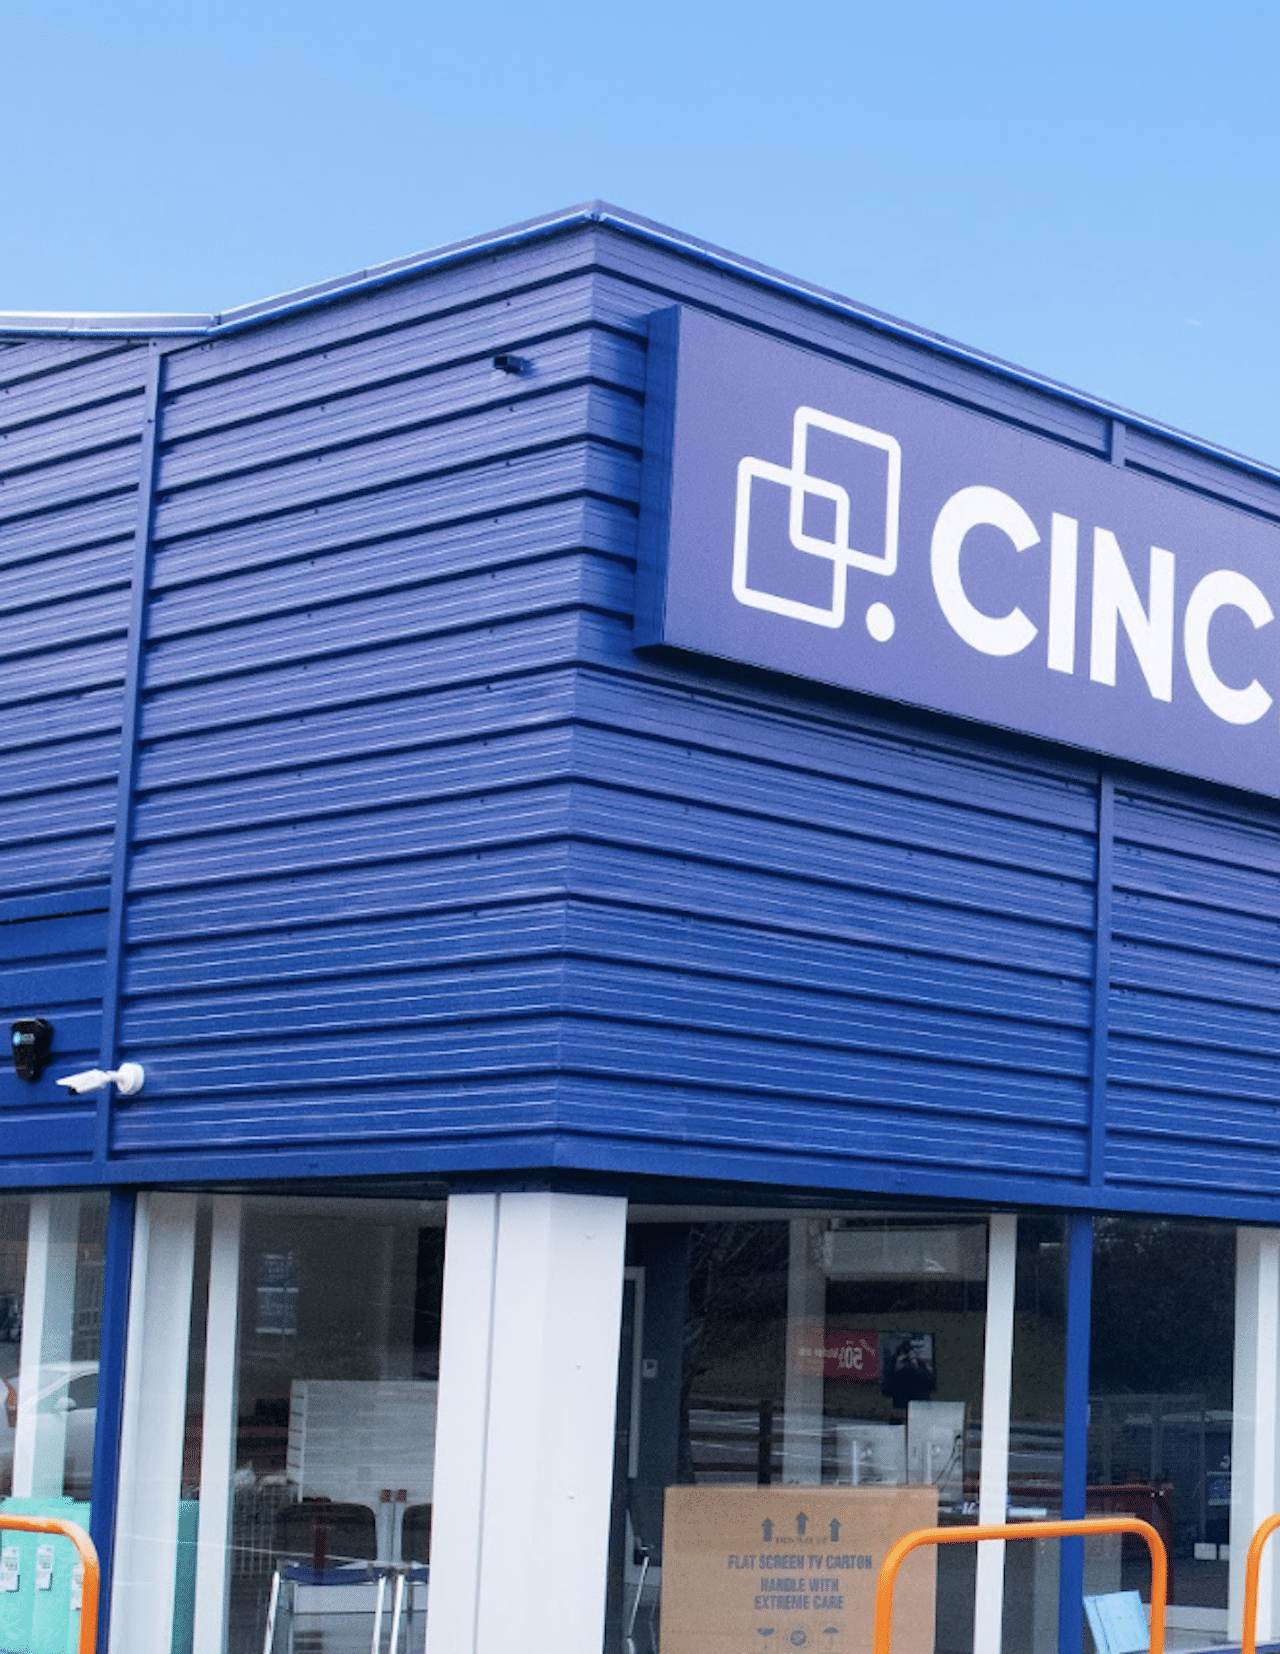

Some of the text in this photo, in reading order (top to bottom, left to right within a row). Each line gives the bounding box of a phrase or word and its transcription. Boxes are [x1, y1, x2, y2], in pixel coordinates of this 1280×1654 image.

[727, 1554, 873, 1570] FLAT SCREEN TV CARTON
[760, 1577, 840, 1592] HANDLE WITH
[754, 1594, 844, 1610] EXTREME CARE
